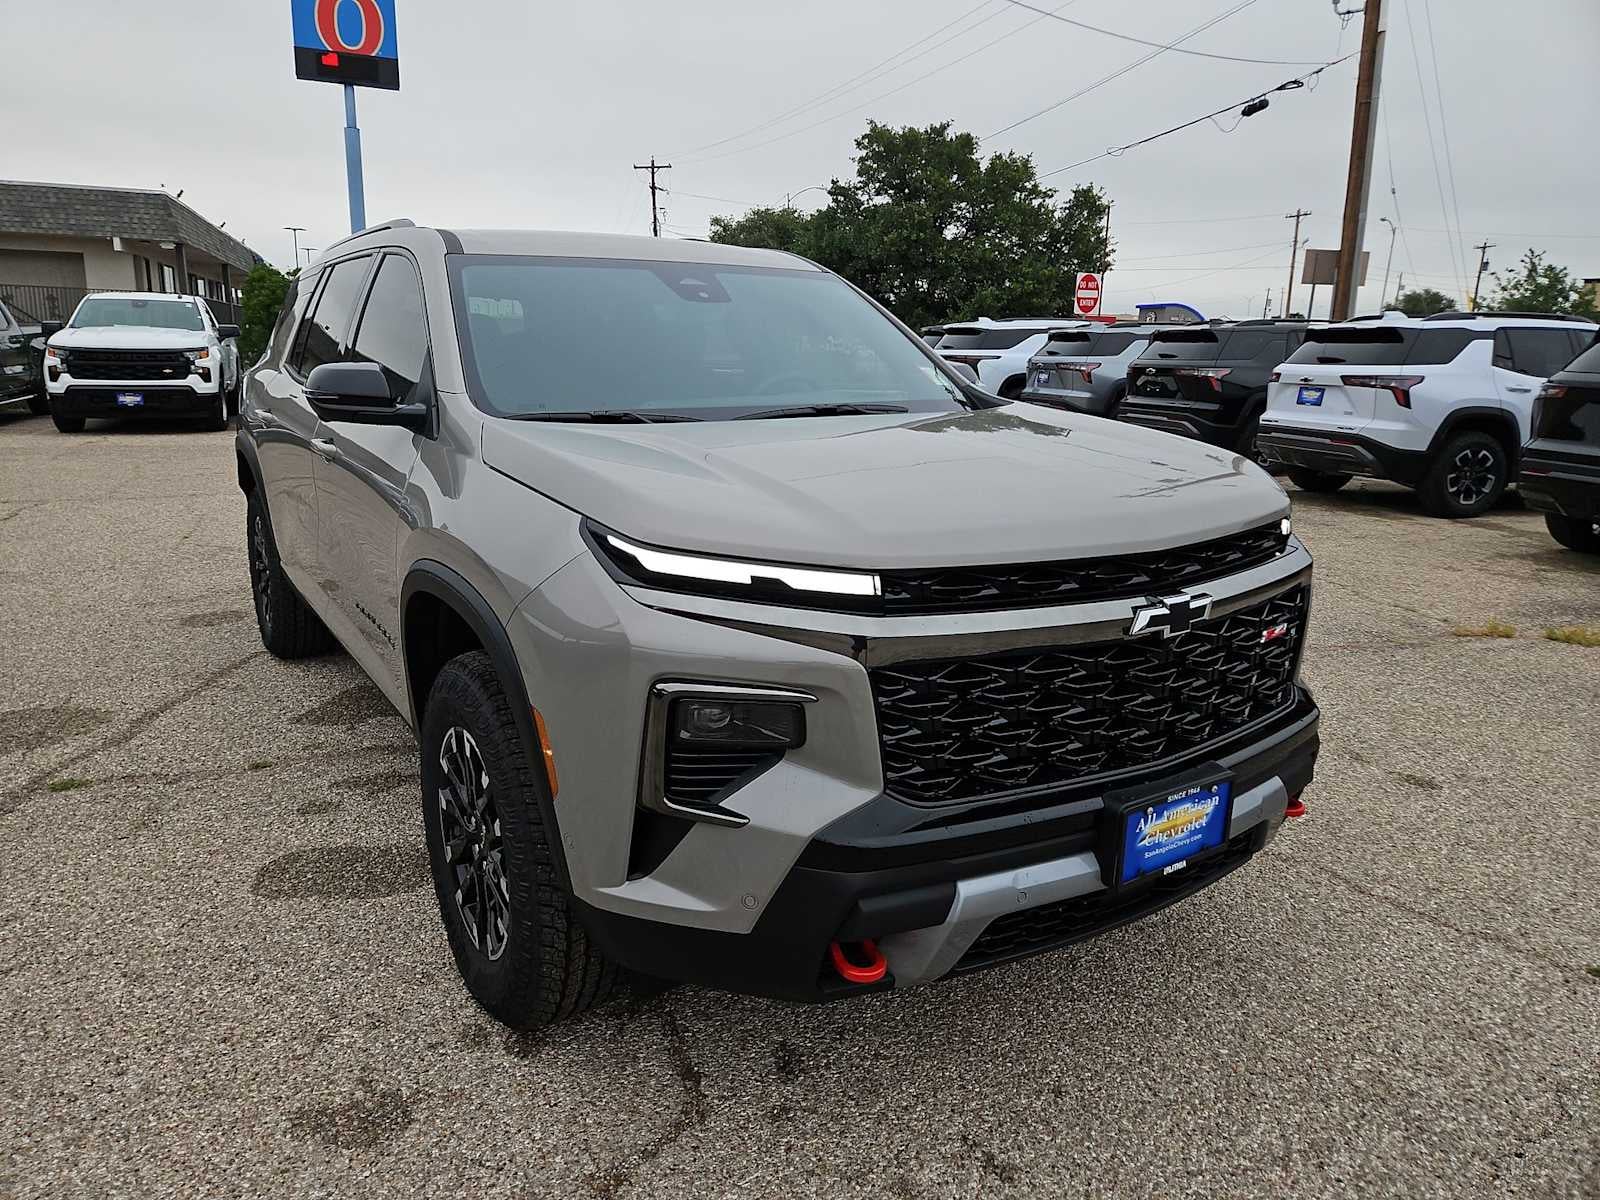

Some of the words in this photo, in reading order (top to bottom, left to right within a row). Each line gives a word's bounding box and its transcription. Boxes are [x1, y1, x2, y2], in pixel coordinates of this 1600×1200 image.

[1080, 281, 1087, 289] DO
[1088, 281, 1098, 289] NOT
[1079, 299, 1095, 307] ENTER
[1167, 790, 1186, 802] SINCE
[1136, 812, 1157, 833] All
[1163, 796, 1219, 820] American
[1143, 815, 1207, 847] Chevrolet
